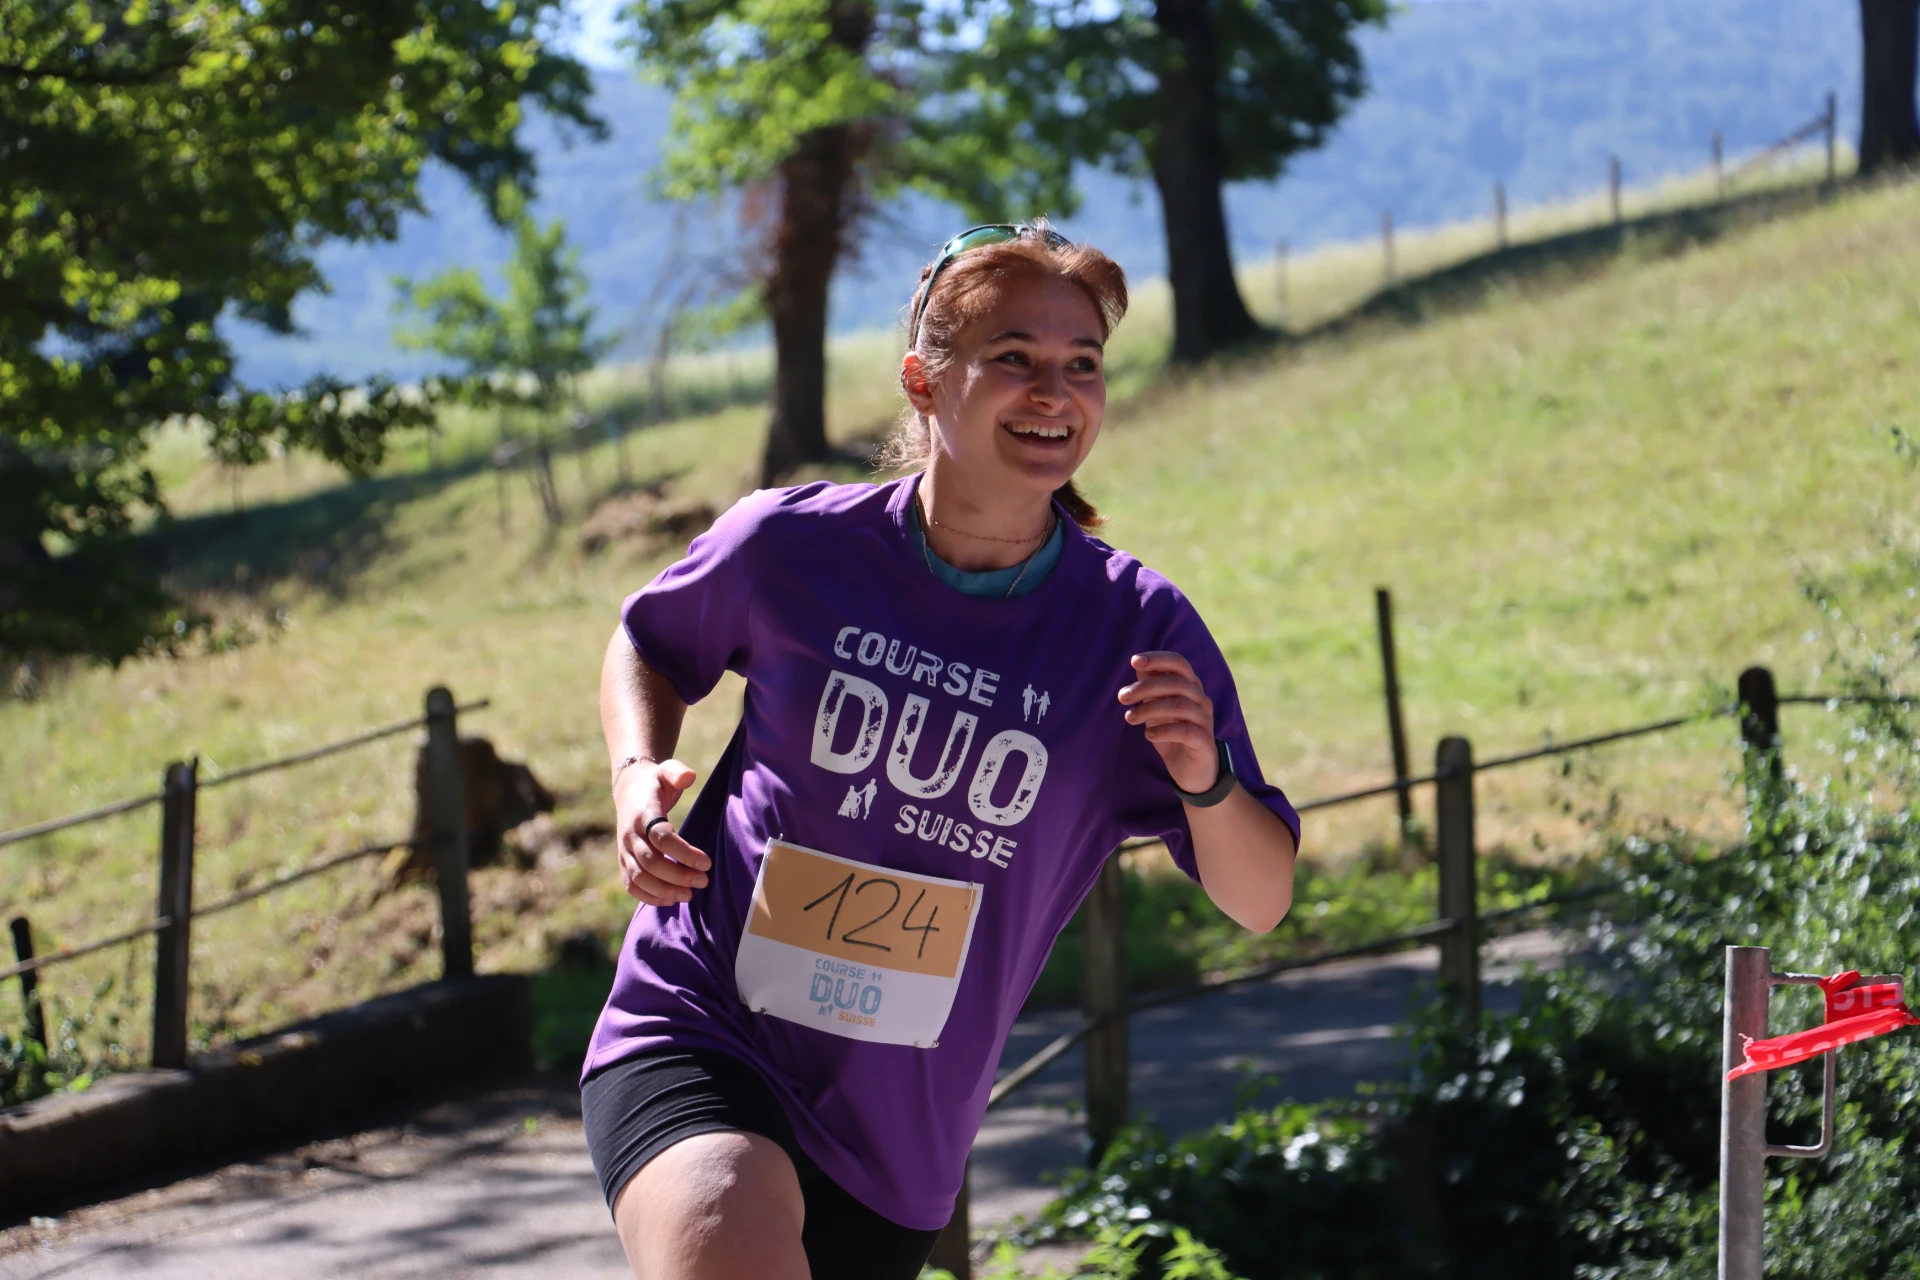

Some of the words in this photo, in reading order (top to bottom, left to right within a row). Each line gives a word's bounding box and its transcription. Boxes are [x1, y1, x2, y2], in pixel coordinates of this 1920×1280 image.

[834, 626, 1000, 707] COURSE
[810, 669, 1048, 826] DUO
[895, 804, 1017, 869] SUISSE
[804, 873, 940, 959] 124
[810, 973, 882, 1015] DUO
[815, 958, 866, 980] COURSE
[838, 1011, 876, 1027] SUISSE
